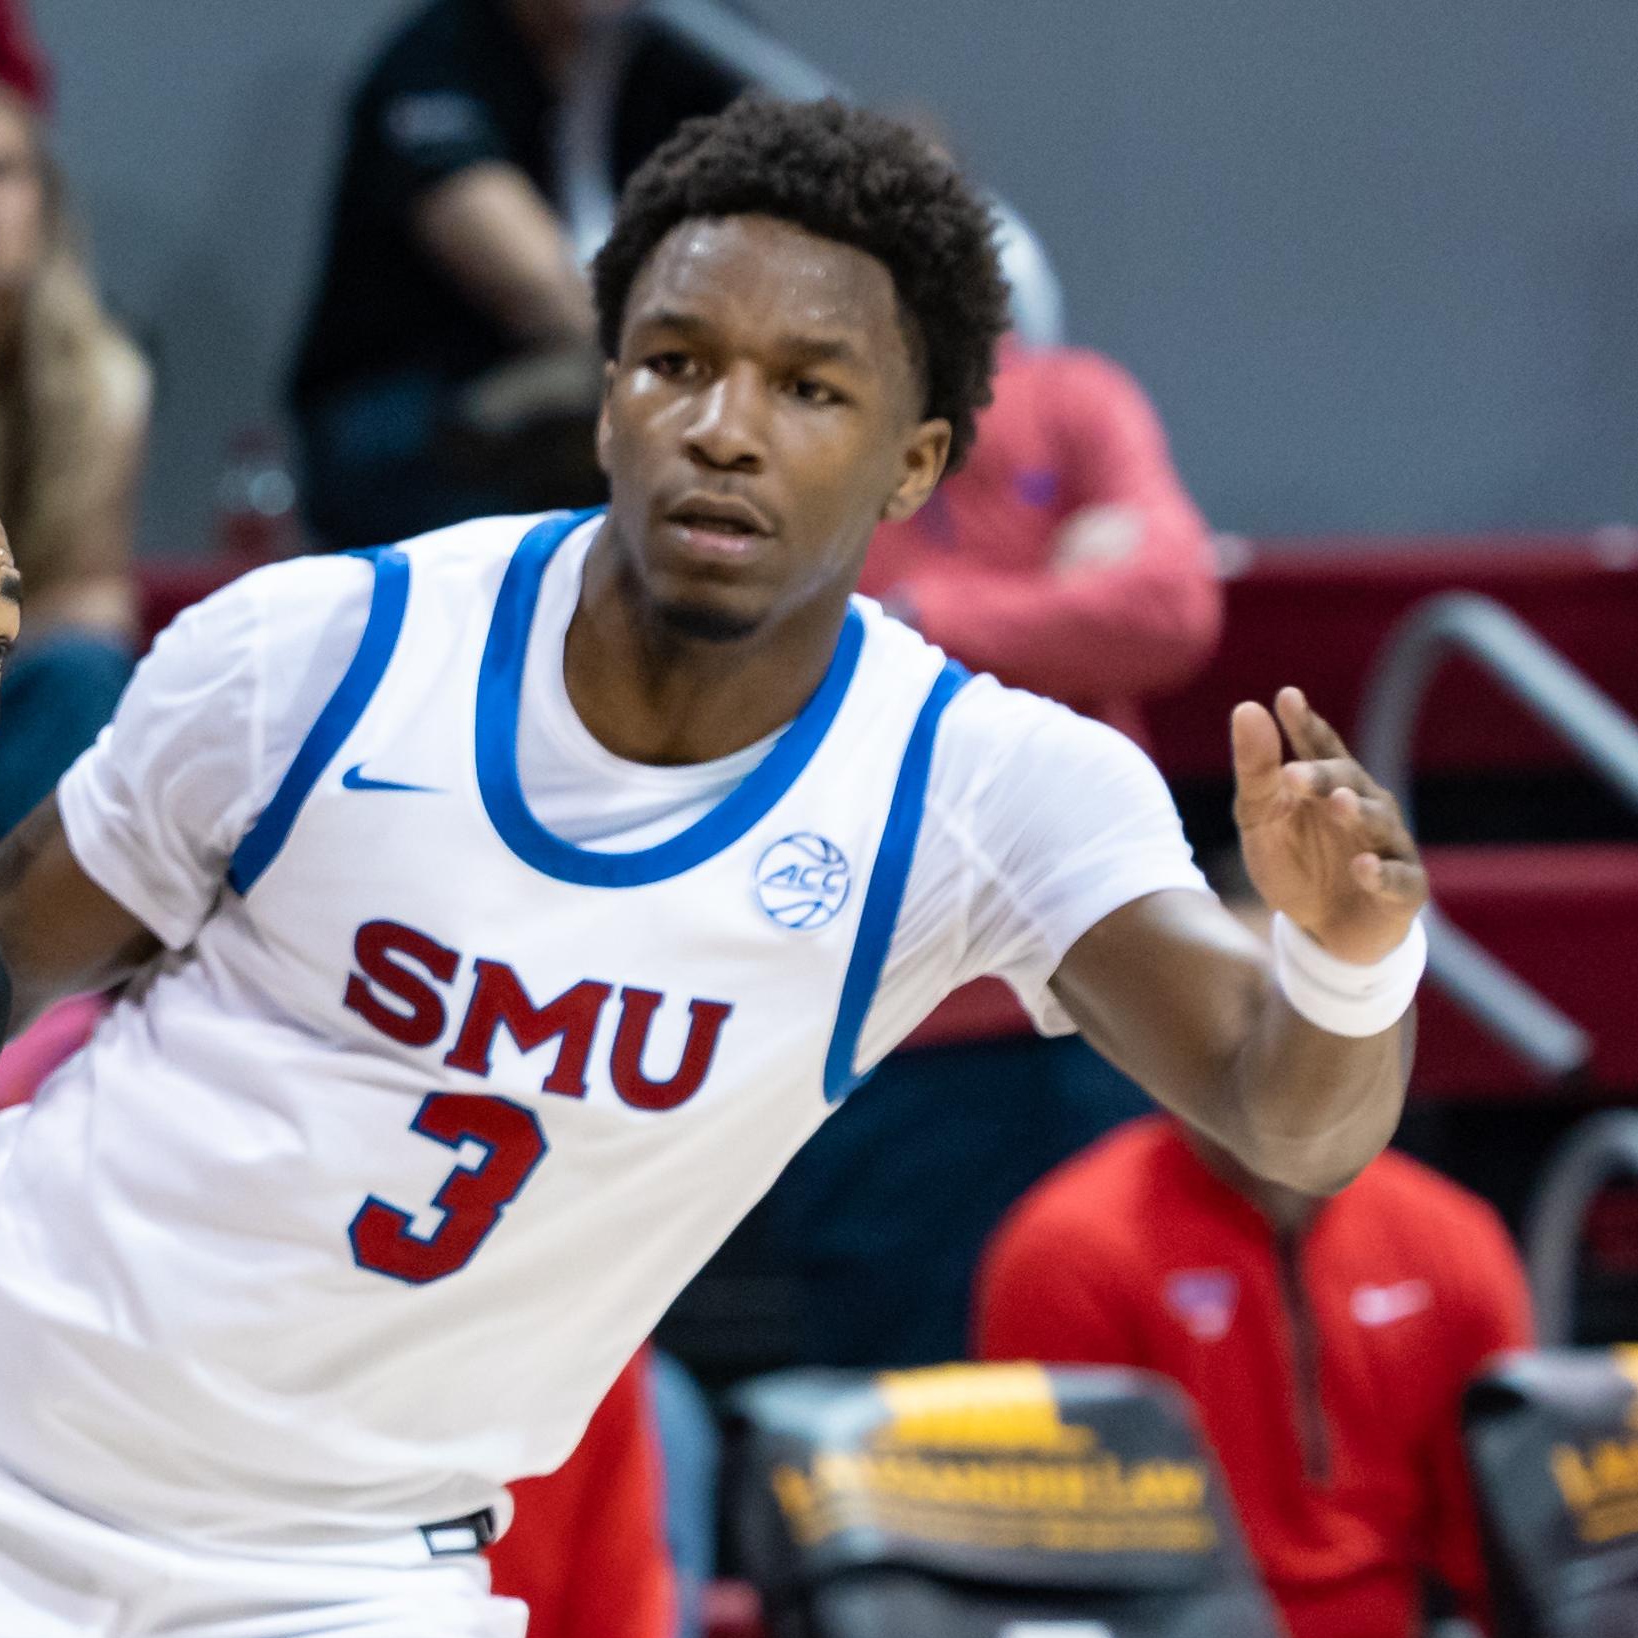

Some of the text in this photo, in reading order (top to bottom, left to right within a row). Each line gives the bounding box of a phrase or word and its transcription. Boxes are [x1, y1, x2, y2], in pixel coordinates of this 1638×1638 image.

[761, 864, 847, 895] ACC
[342, 917, 736, 1113] SMU
[347, 1089, 550, 1287] 3
